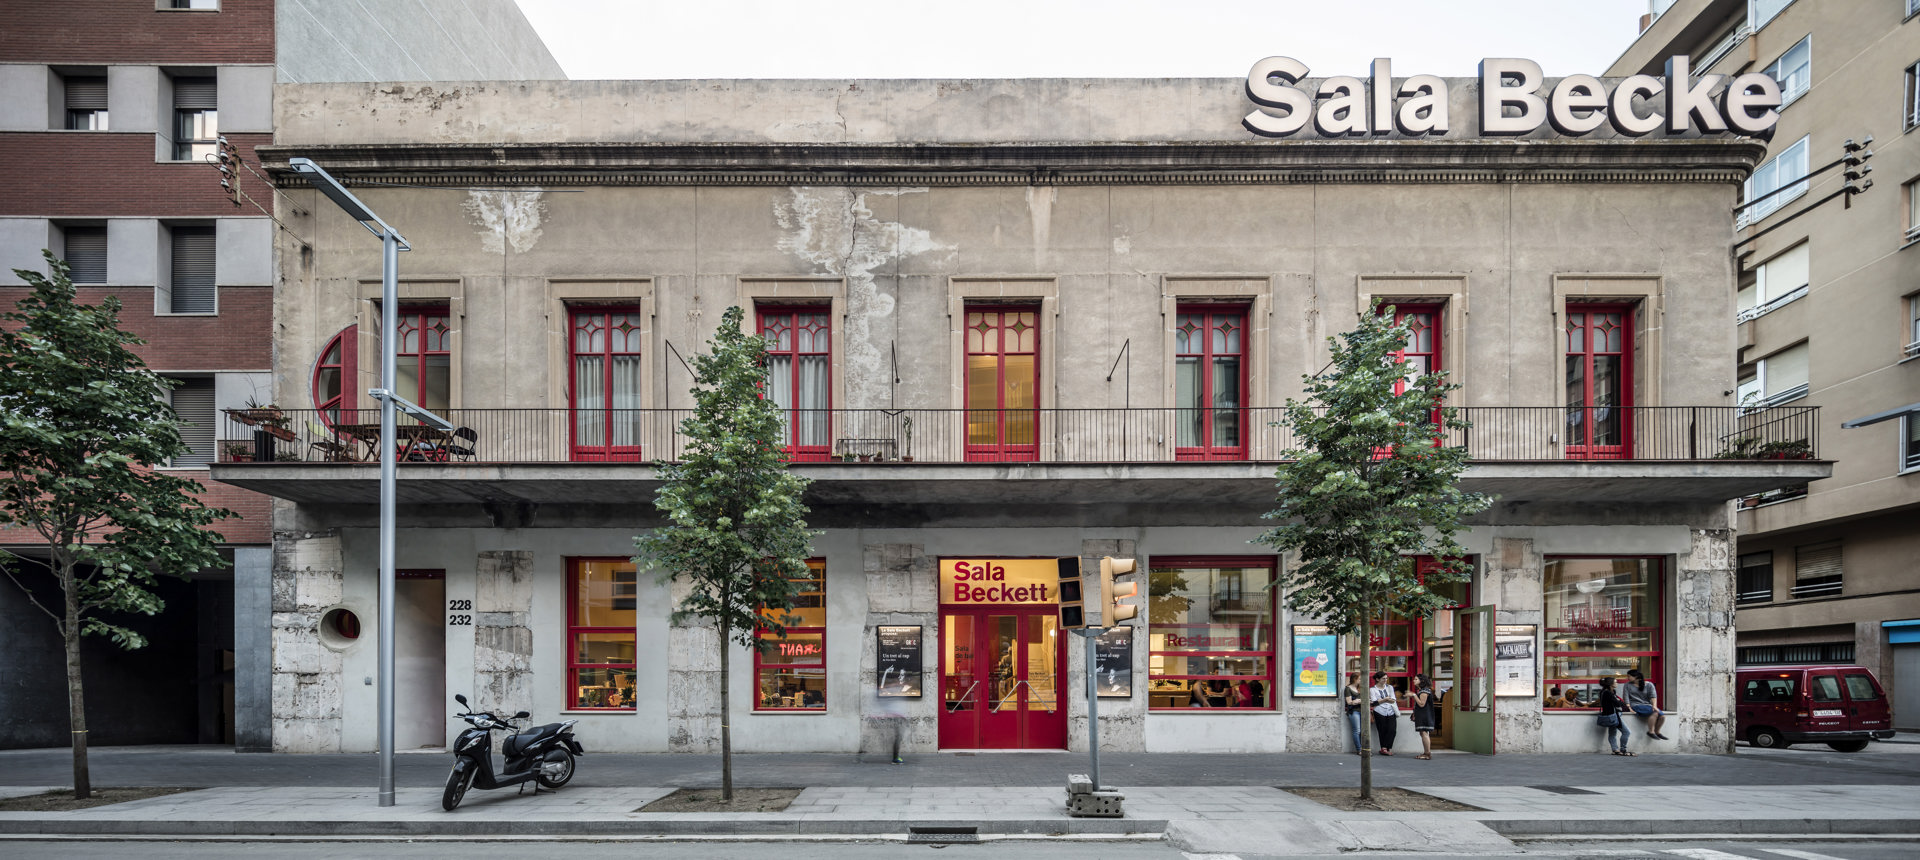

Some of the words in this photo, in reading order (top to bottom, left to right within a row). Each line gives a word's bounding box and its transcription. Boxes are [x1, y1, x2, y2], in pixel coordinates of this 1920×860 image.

[1243, 55, 1449, 137] Sala
[954, 561, 1005, 581] Sala
[954, 583, 1048, 602] Beckett
[449, 600, 471, 610] 228
[449, 615, 471, 625] 232
[1167, 633, 1251, 647] Restaurant
